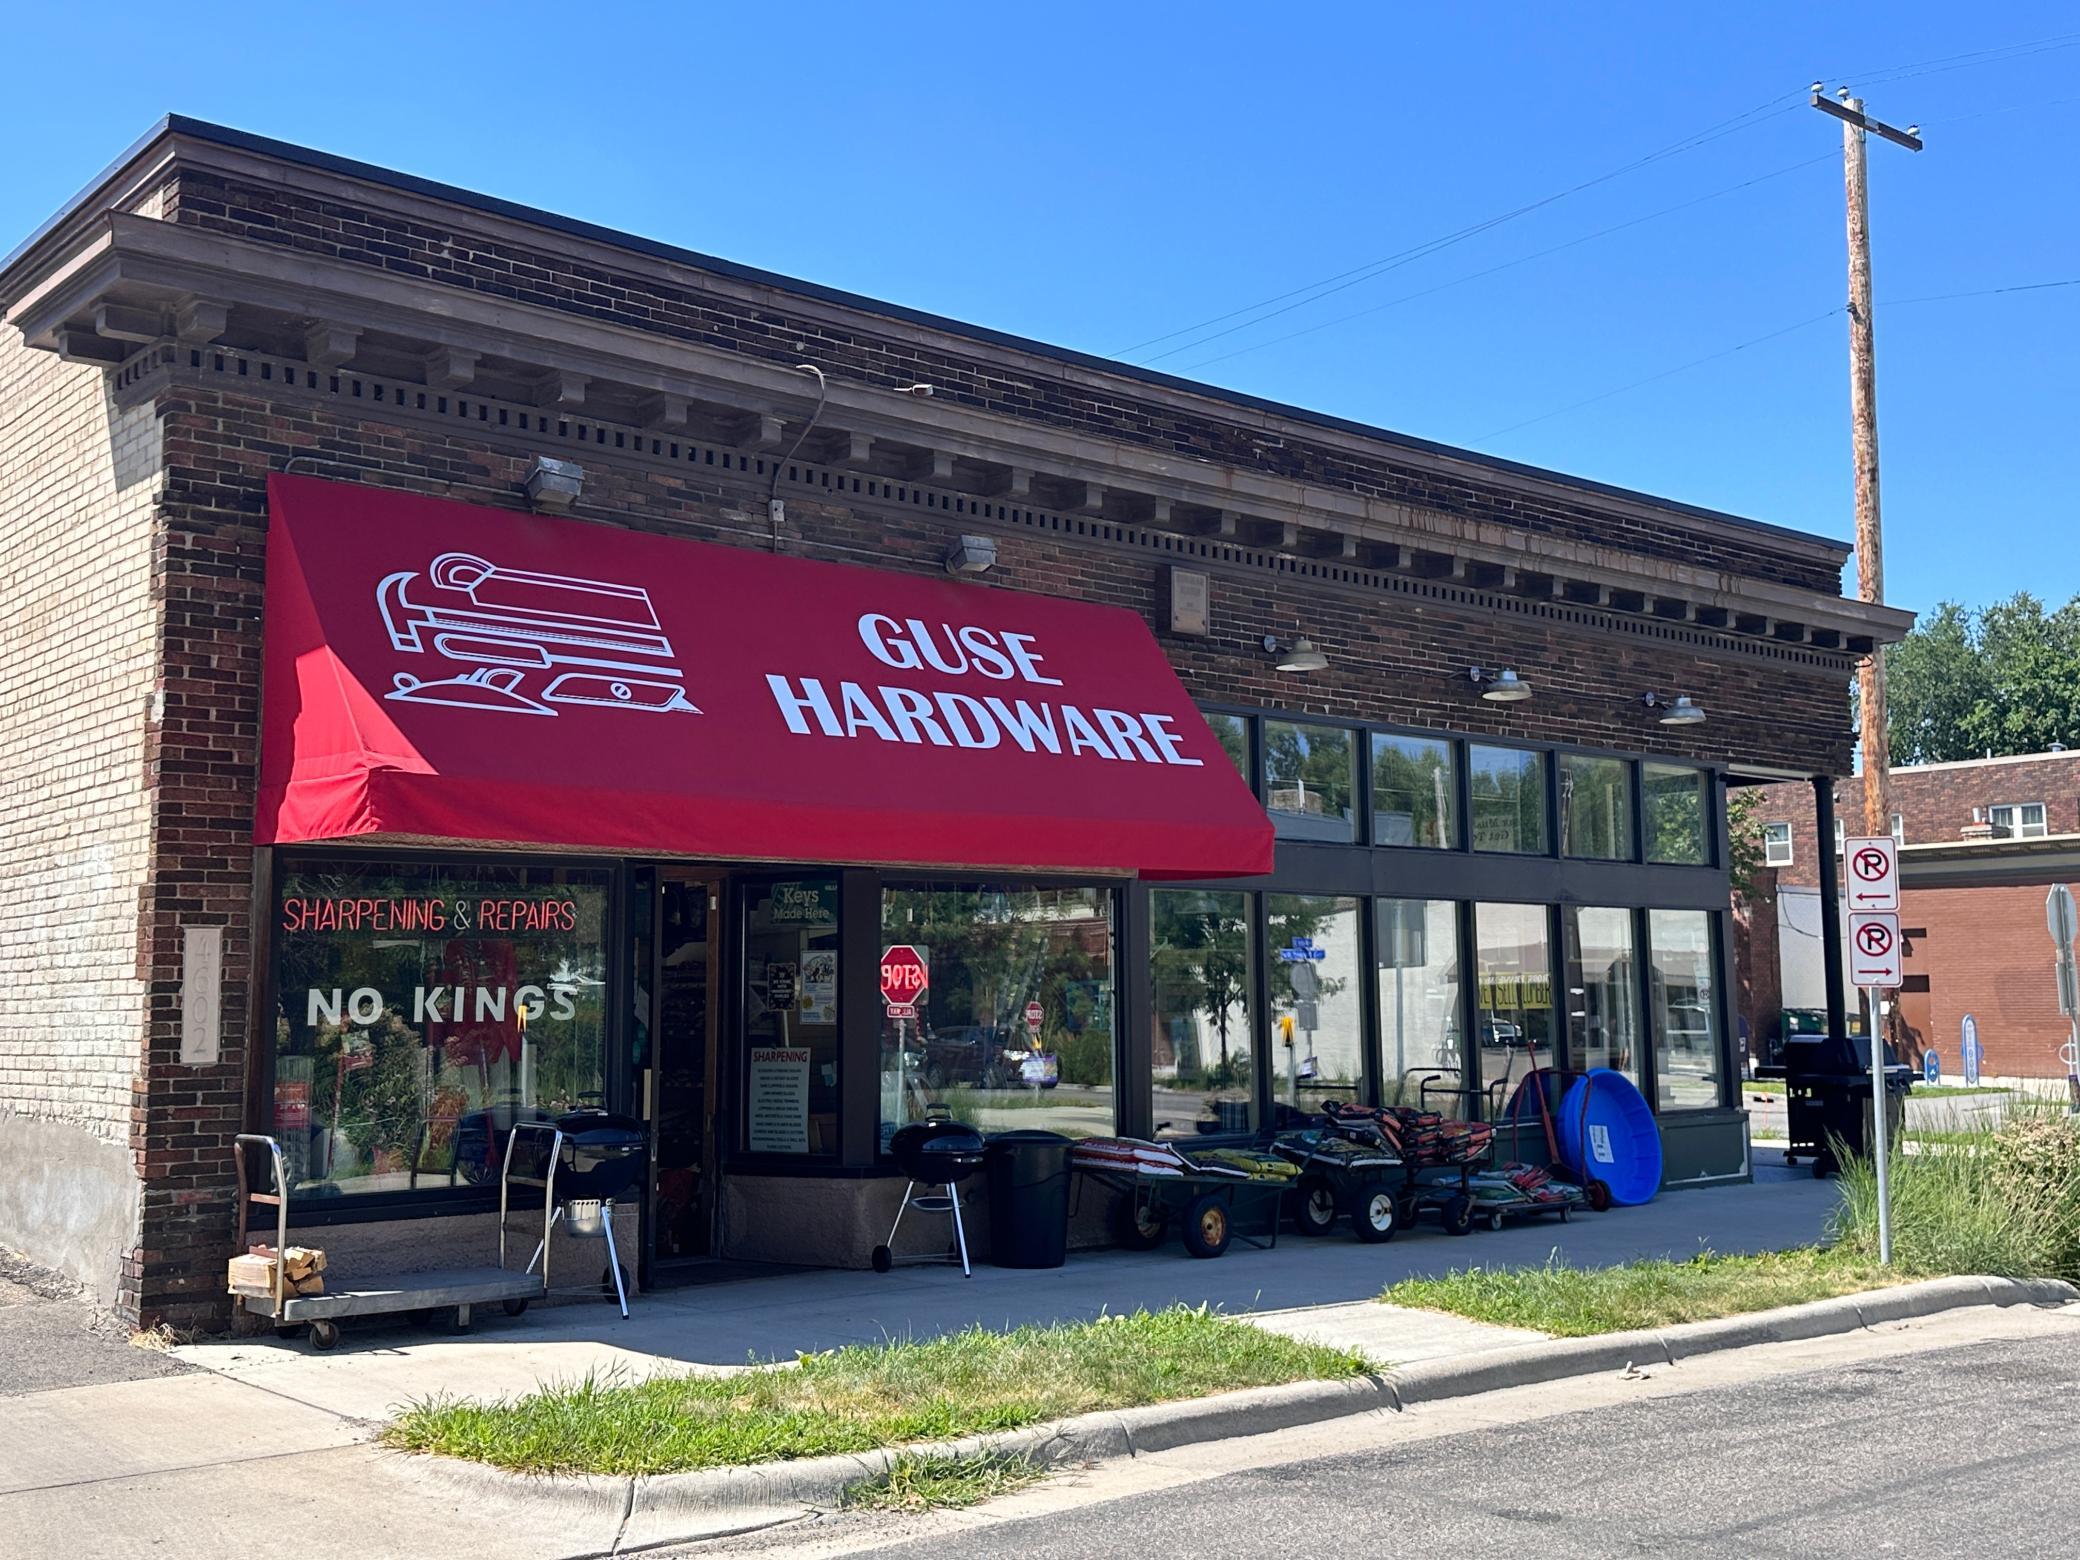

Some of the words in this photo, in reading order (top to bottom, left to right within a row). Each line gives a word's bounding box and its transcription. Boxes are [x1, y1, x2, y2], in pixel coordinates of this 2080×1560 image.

[858, 612, 1064, 686] GUSE
[765, 673, 1204, 766] HARDWARE
[283, 898, 446, 931] SHARPENING
[453, 900, 472, 929] &
[479, 899, 577, 931] REPAIRS
[773, 907, 803, 920] Made
[805, 907, 830, 919] Here
[784, 888, 819, 907] Keys
[192, 935, 211, 1055] 4602
[307, 987, 384, 1027] NO
[414, 985, 577, 1023] KINGS
[753, 1050, 808, 1063] SHARPENING
